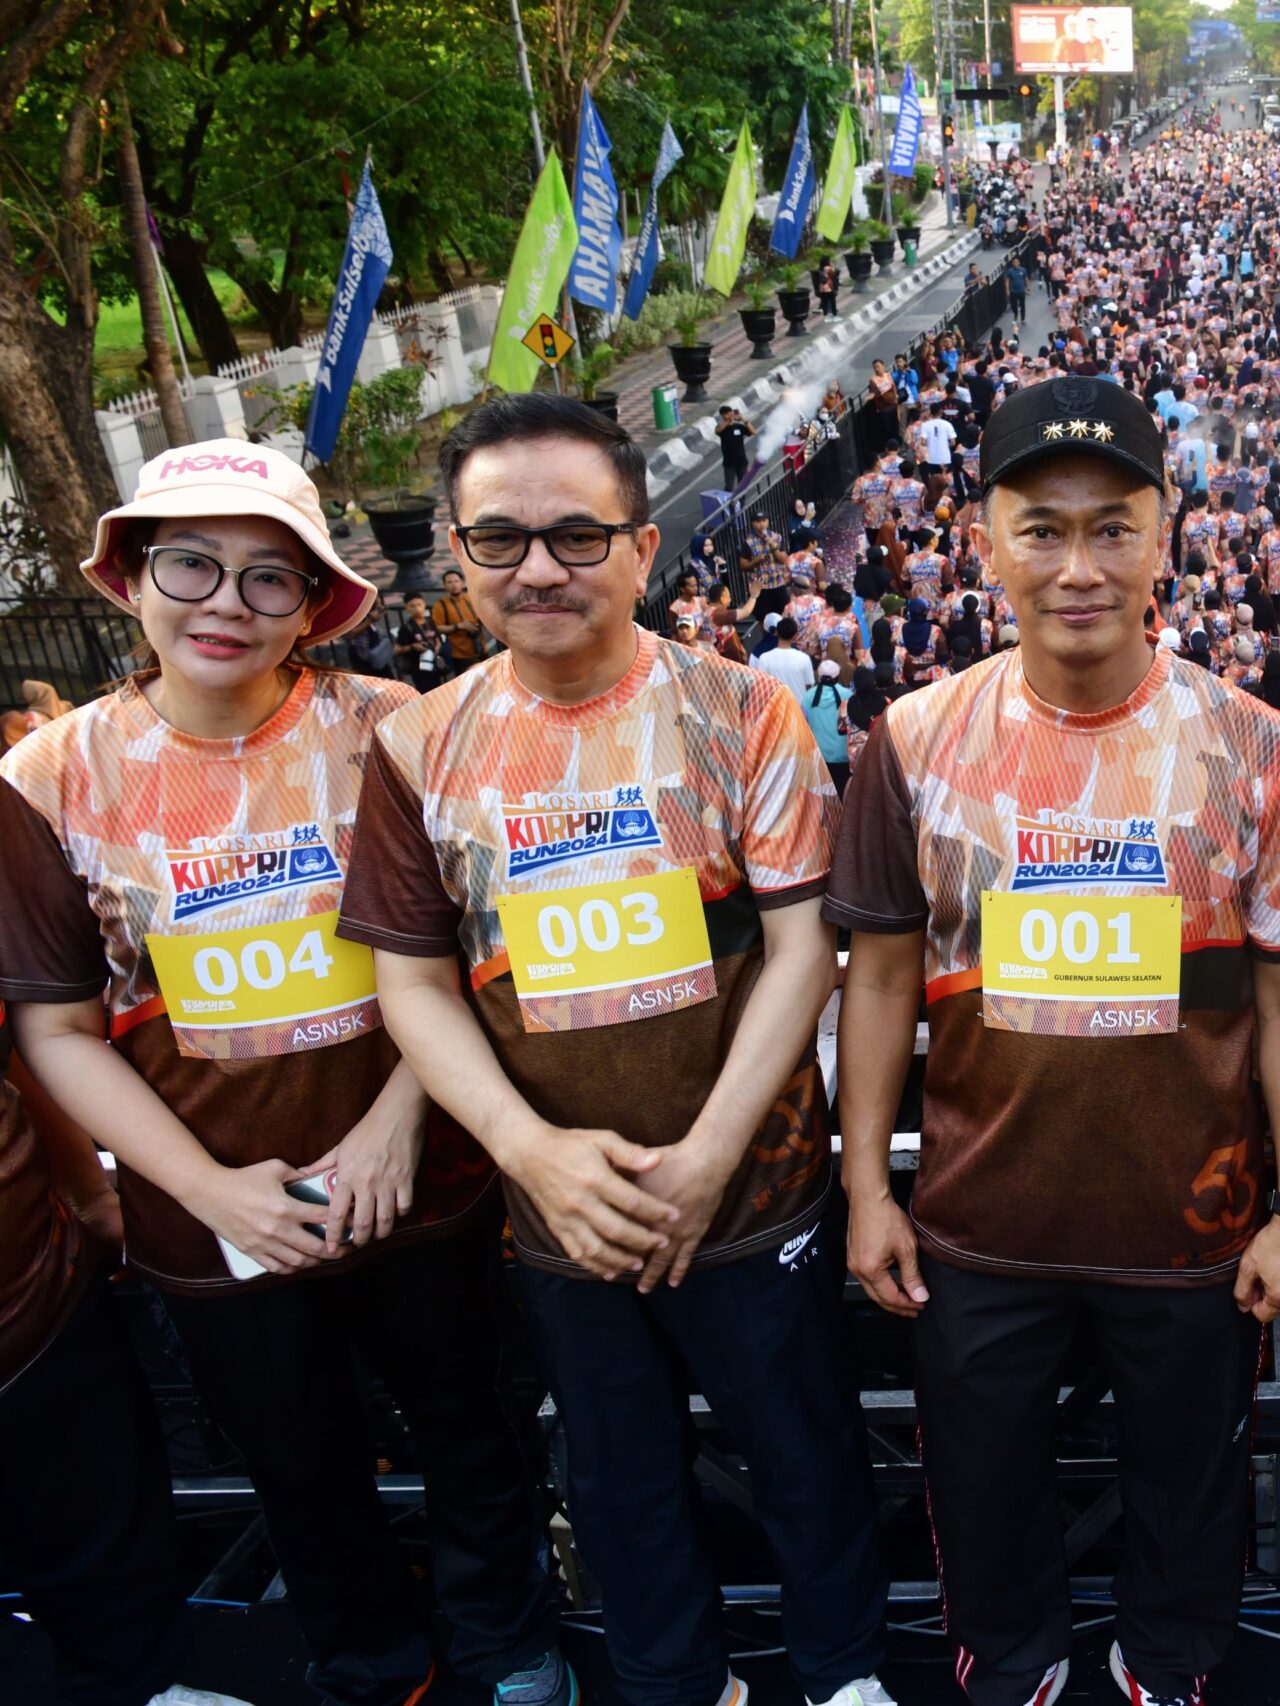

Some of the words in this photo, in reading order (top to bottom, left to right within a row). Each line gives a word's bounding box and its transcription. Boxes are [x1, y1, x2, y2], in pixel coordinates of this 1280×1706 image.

[159, 454, 269, 480] HOKA
[533, 793, 610, 811] LOSARI
[505, 811, 611, 850] KORPRI
[1047, 810, 1122, 838] LOSARI
[201, 833, 287, 852] LOSARI
[509, 833, 608, 865] RUN2024
[1017, 830, 1121, 864] KORPRI
[169, 849, 288, 894] KORPRI
[1015, 863, 1115, 878] RUN2024
[175, 872, 287, 907] RUN2024
[537, 892, 665, 958] 003
[1019, 908, 1140, 964] 001
[192, 930, 334, 996] 004
[1053, 973, 1094, 982] GUBERNUR
[1095, 974, 1131, 982] SULAWESI
[1131, 974, 1162, 982] SELATAN
[628, 979, 699, 1012] ASN5K
[291, 1012, 366, 1045] ASN5K
[1089, 1009, 1160, 1028] ASN5K
[789, 1247, 819, 1272] AIR
